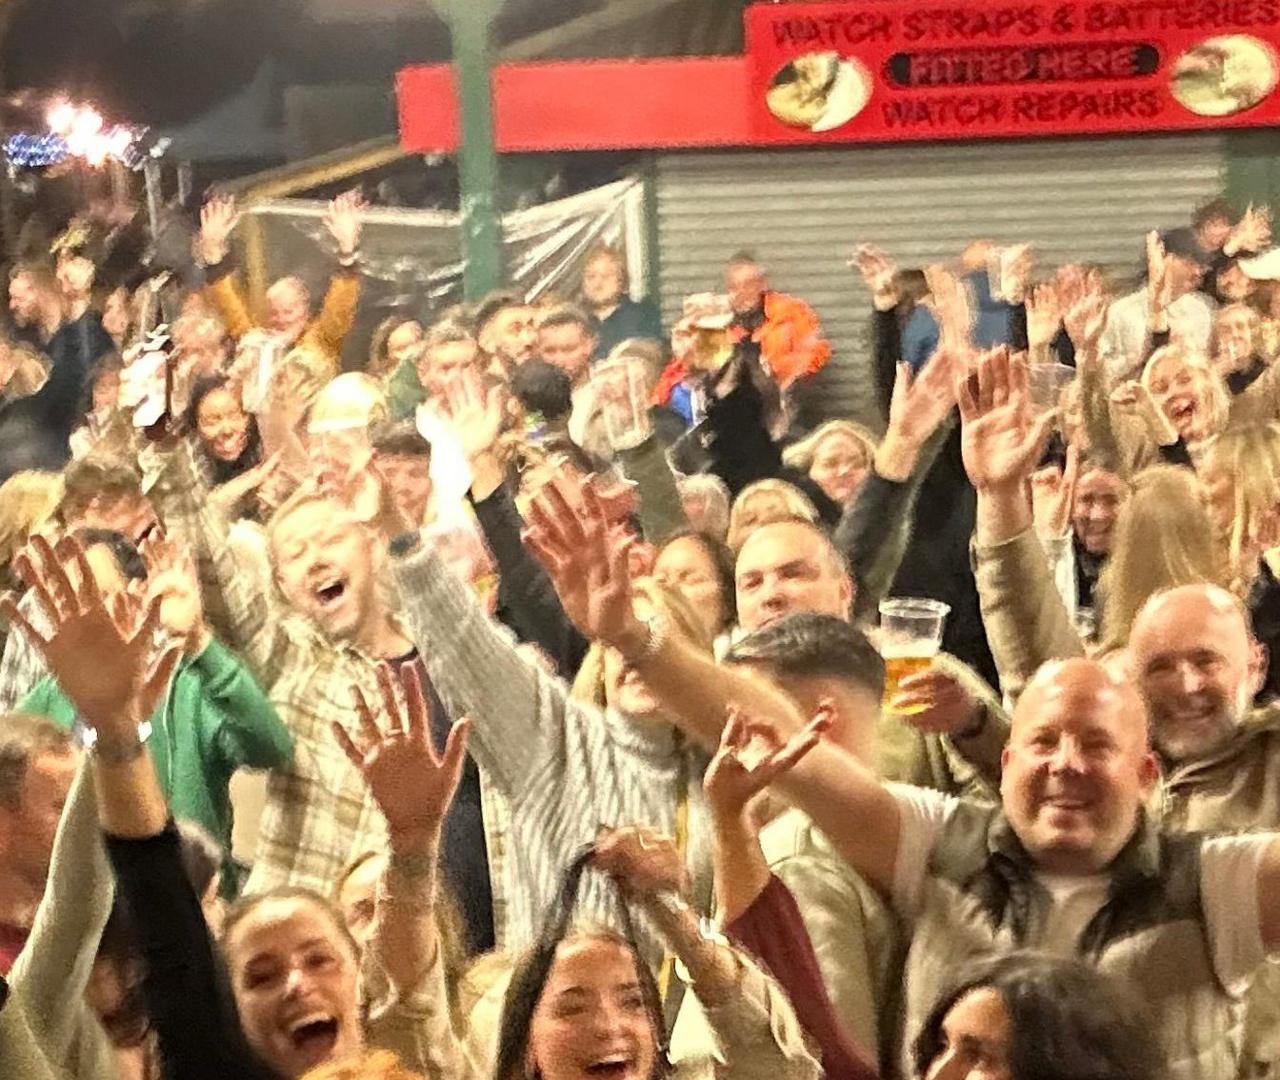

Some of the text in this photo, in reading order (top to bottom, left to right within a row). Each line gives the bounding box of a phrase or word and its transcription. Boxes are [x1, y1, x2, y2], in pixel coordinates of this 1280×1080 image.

[772, 0, 1280, 45] WATCH STRAPS & BATTERIES
[910, 44, 1137, 84] FITTED HERE
[882, 87, 1162, 128] WATCH REPAIRS
